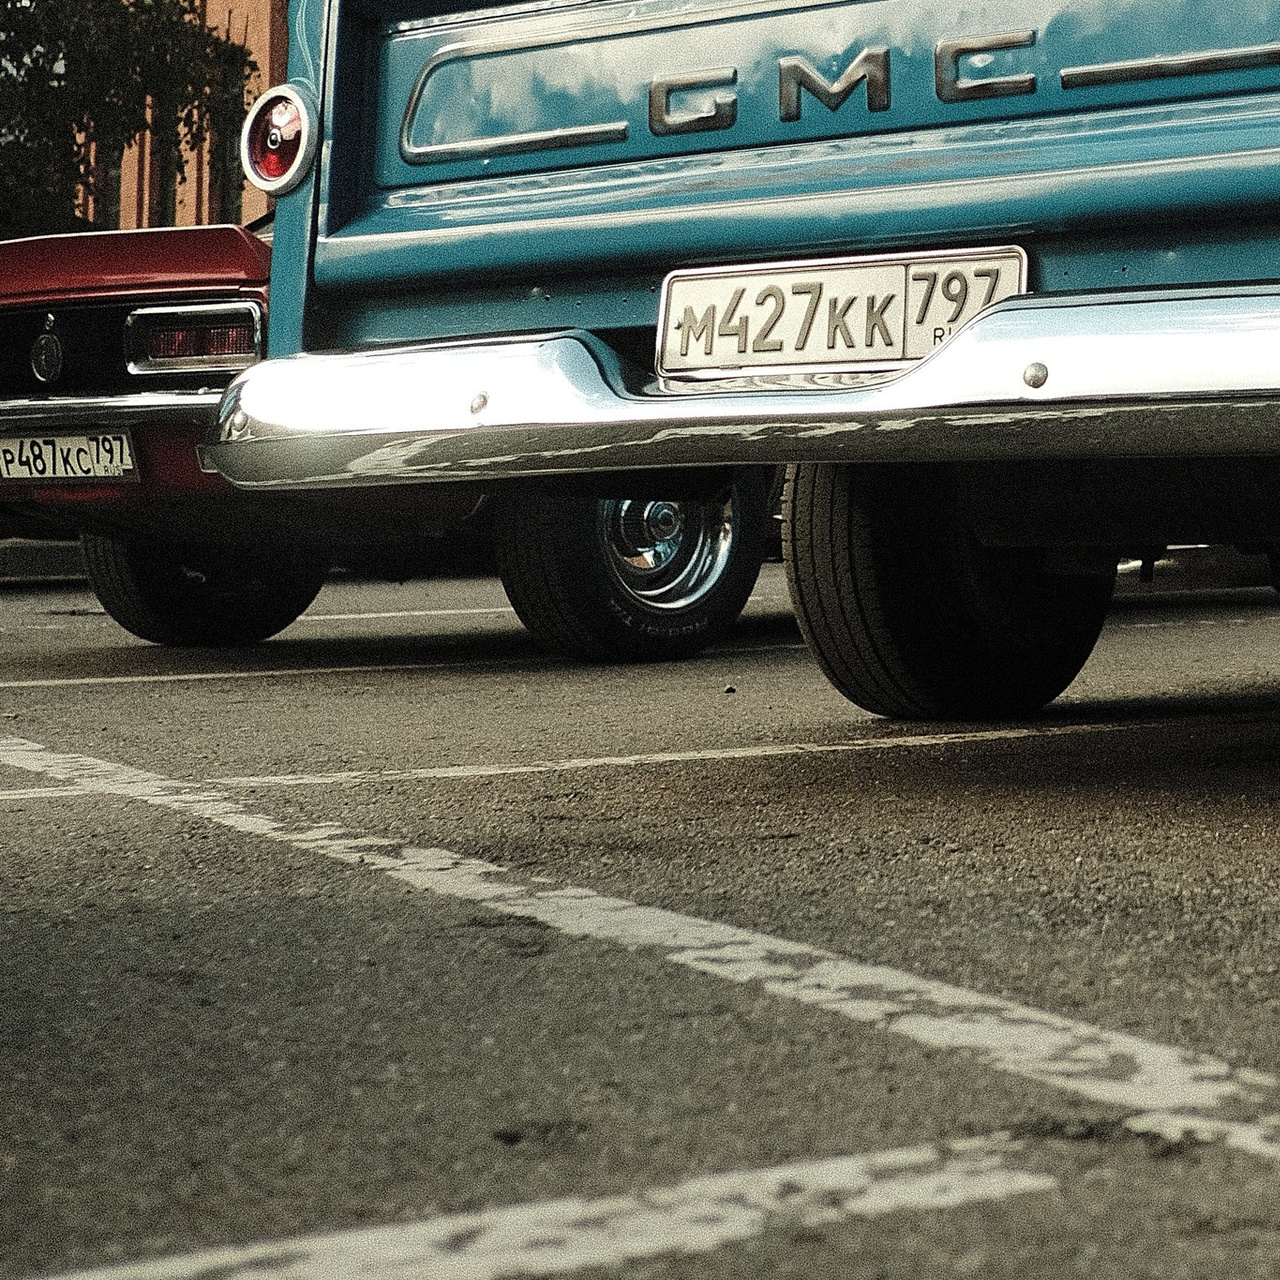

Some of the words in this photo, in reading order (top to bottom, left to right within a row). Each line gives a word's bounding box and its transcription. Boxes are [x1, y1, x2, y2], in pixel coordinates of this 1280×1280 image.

[649, 29, 1036, 137] GMC
[911, 268, 1000, 325] 797
[89, 435, 125, 465] 797
